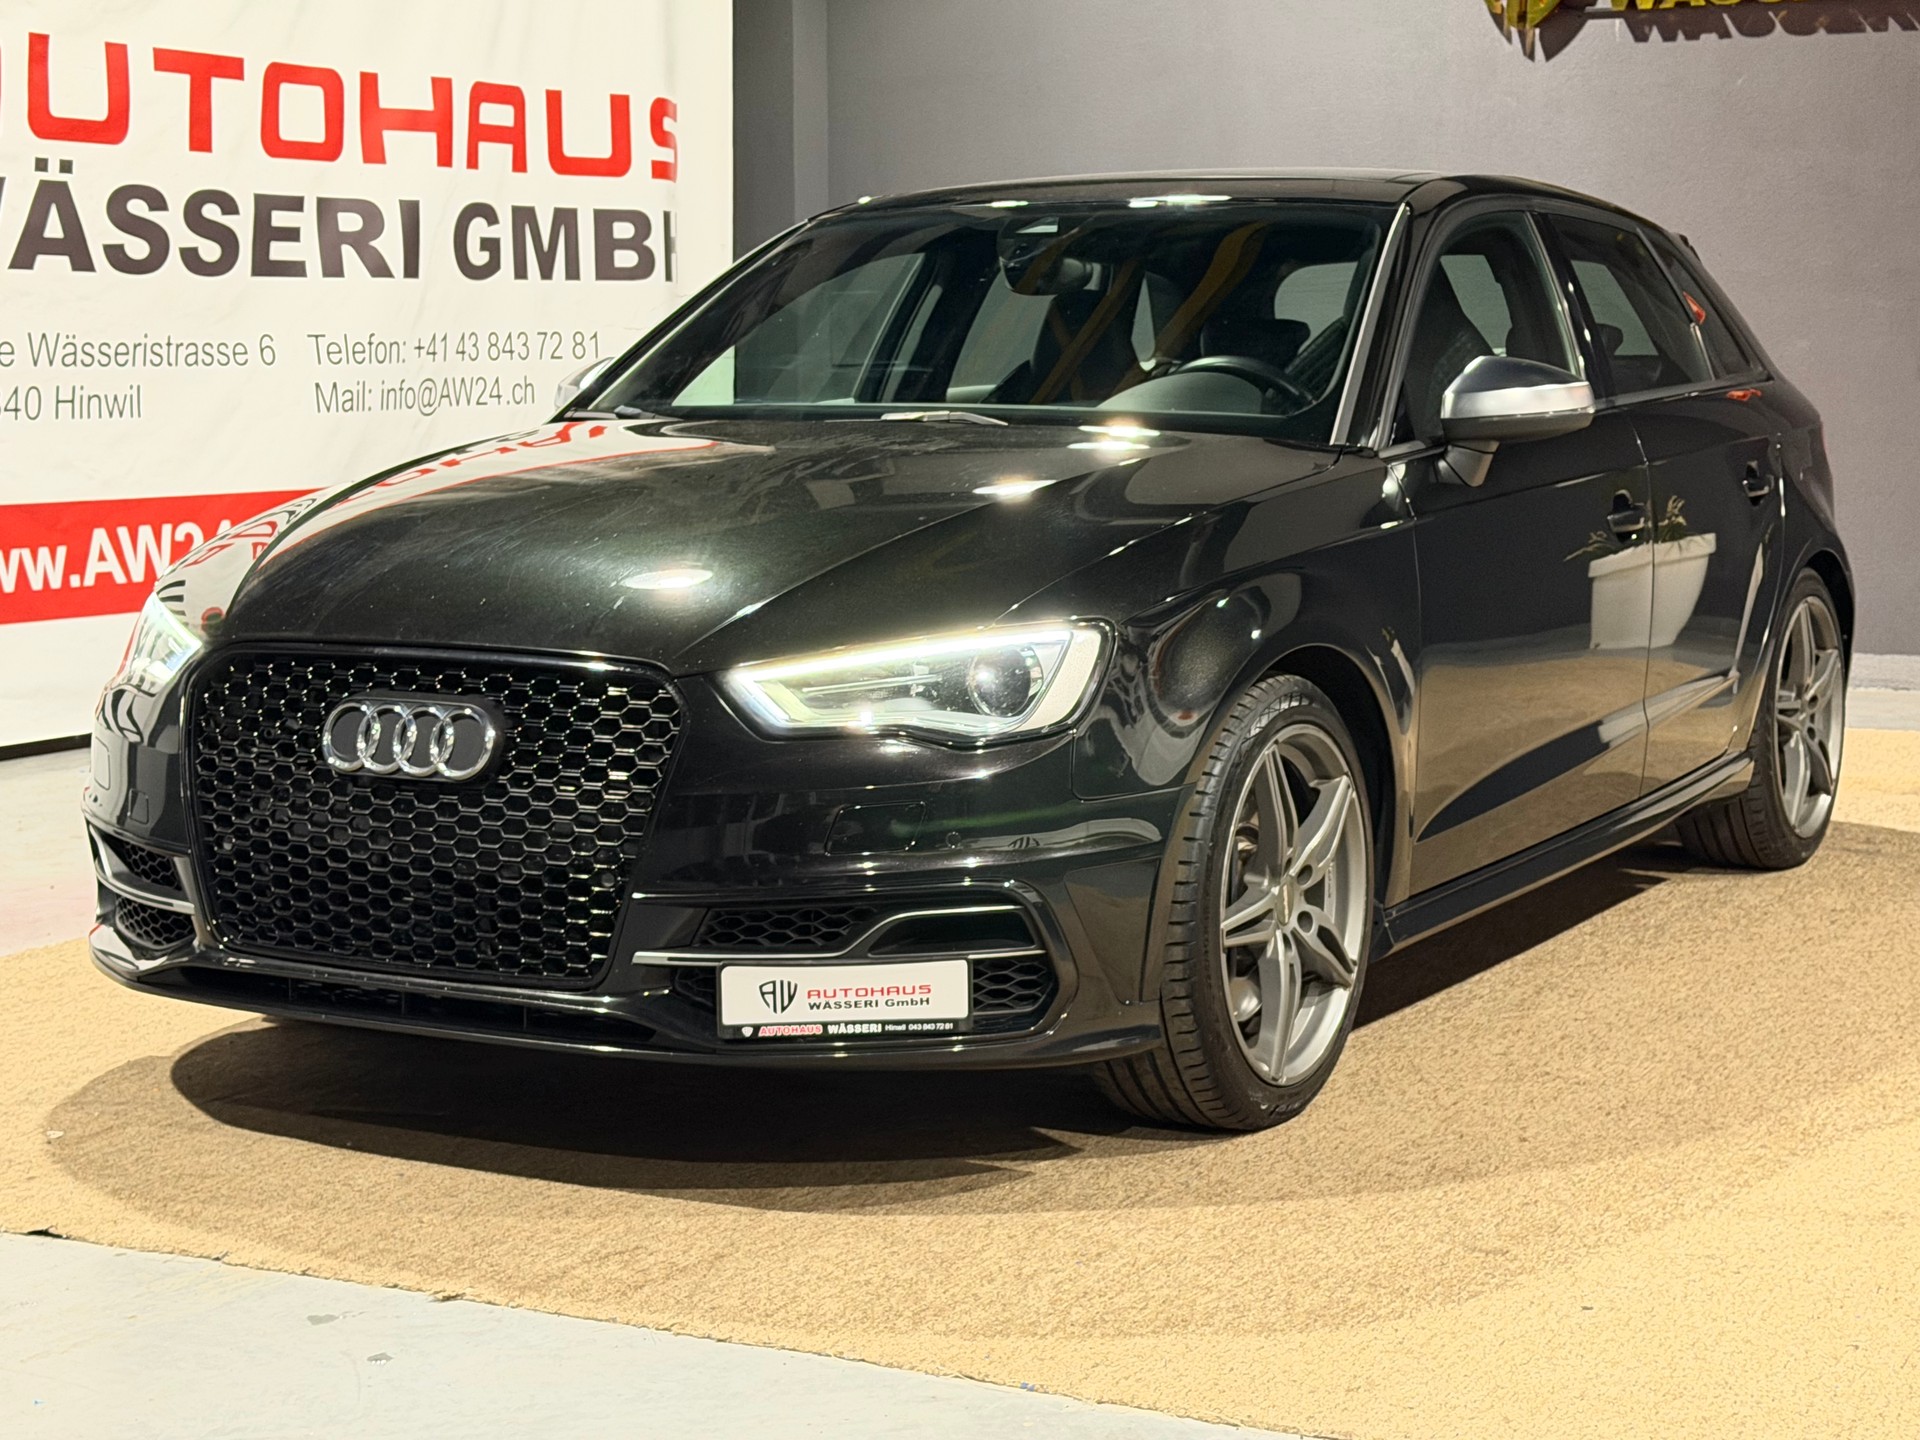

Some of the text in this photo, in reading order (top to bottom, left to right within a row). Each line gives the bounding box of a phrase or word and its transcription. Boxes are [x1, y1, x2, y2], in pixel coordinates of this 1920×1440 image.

[0, 32, 677, 183] UTOHAUS
[0, 157, 420, 279] ÄSSERI
[27, 332, 249, 368] Wässeristrasse
[259, 333, 276, 366] 6
[307, 329, 599, 365] Telefon: +41 43 843 72 81
[0, 384, 142, 421] 40 Hinwil
[314, 374, 535, 417] Mail: info@AW24.ch
[807, 984, 932, 1000] AUTOHAUS
[884, 997, 931, 1009] GmbH
[758, 1024, 823, 1037] AUTOHAUS
